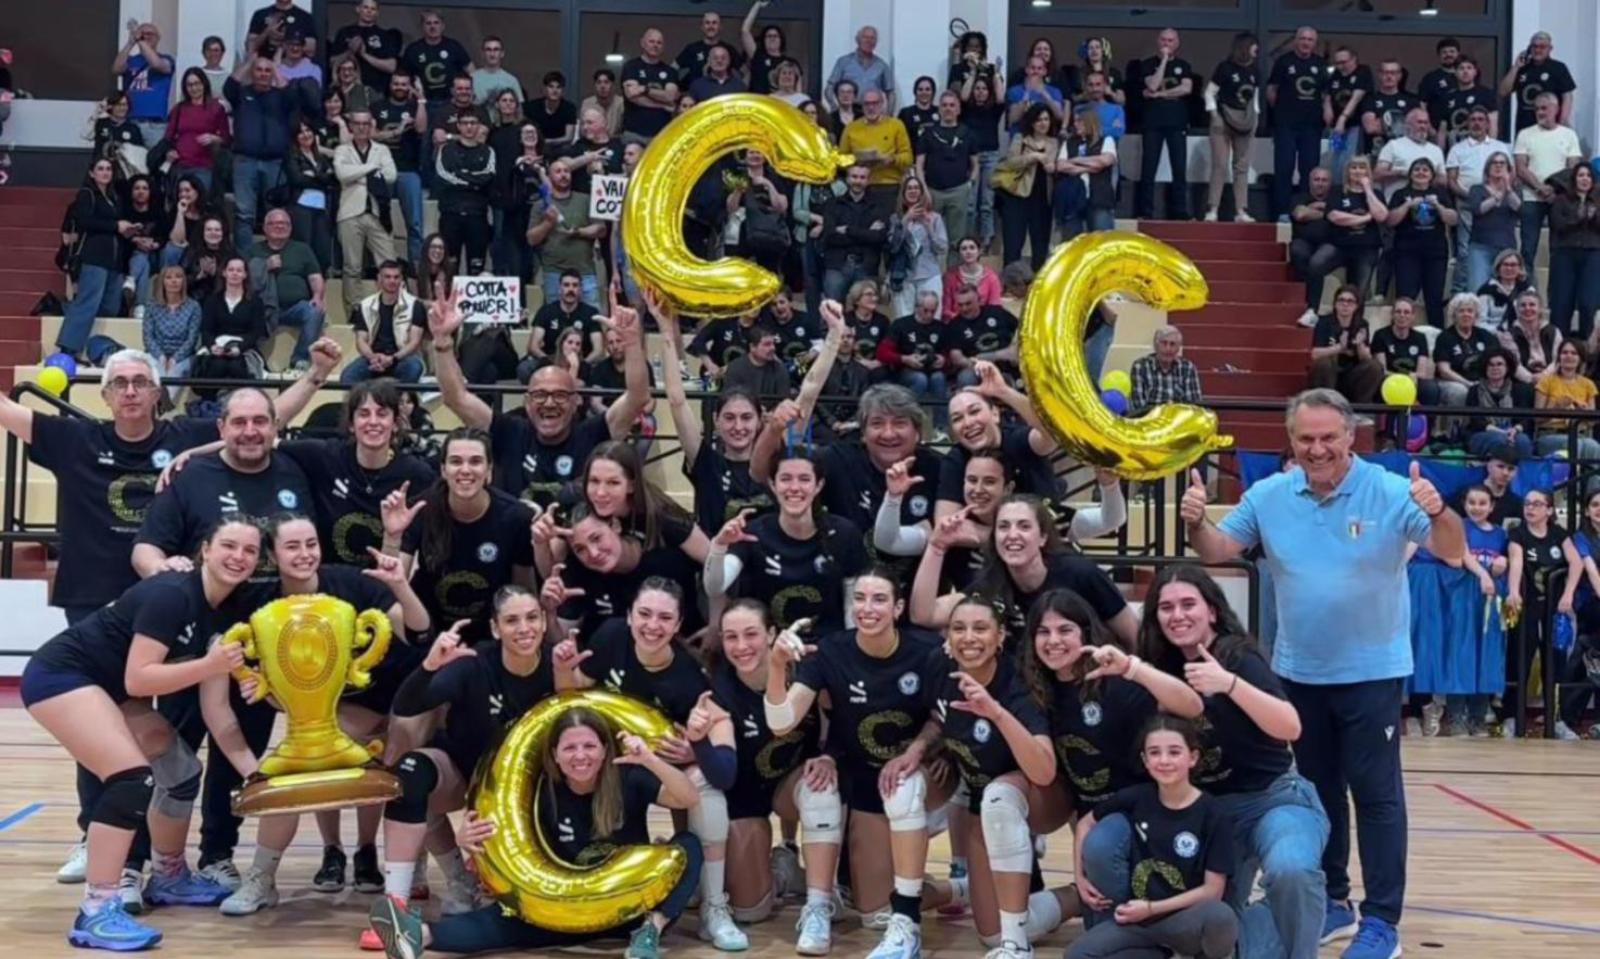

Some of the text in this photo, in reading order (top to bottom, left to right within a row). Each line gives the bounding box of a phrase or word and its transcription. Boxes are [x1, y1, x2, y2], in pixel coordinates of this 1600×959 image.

[465, 280, 508, 298] COTTA
[601, 179, 624, 197] VAI
[622, 93, 855, 318] C
[1019, 230, 1234, 480] C
[467, 689, 688, 933] C
